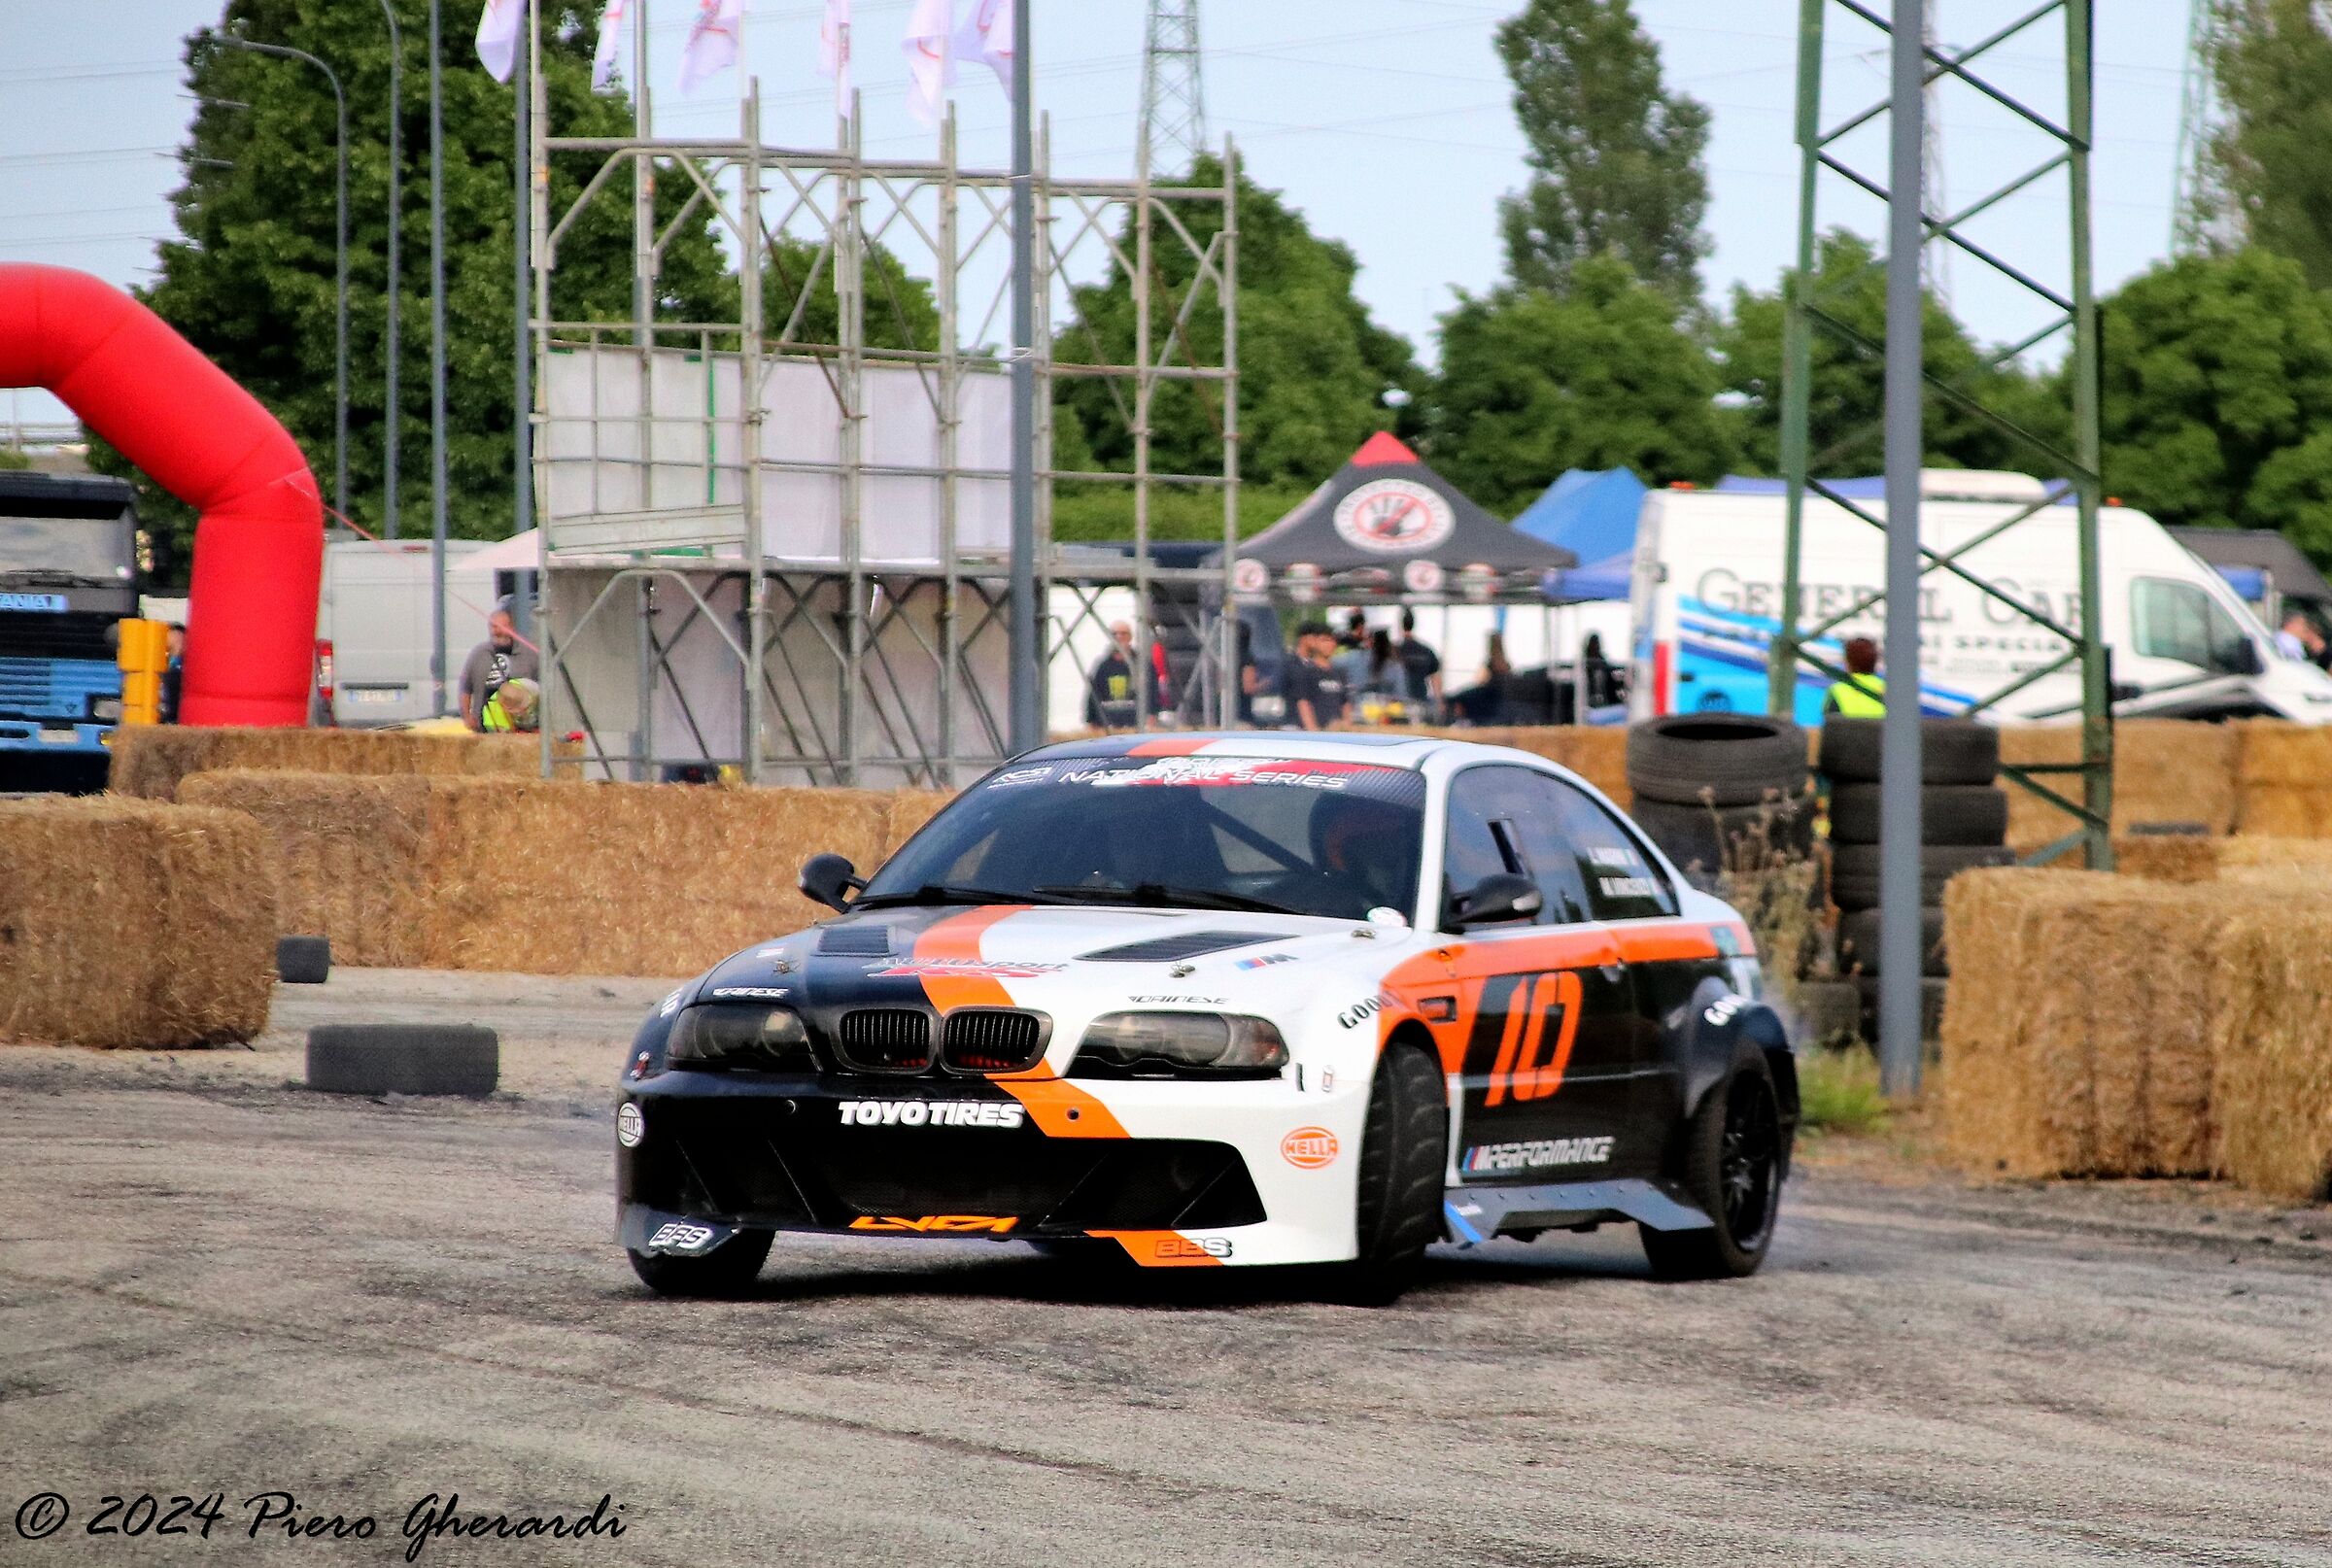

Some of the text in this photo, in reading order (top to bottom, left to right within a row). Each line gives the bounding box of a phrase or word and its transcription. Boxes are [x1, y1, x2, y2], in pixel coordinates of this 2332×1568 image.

[1697, 567, 1952, 622] GEERL
[1057, 768, 1219, 788] NATIONAL
[1234, 768, 1349, 789] SERIES
[1127, 995, 1228, 1005] DAINESE
[838, 1101, 1025, 1129] TOYO TIRES
[1285, 1138, 1339, 1156] HELLA
[1154, 1238, 1233, 1258] BBS
